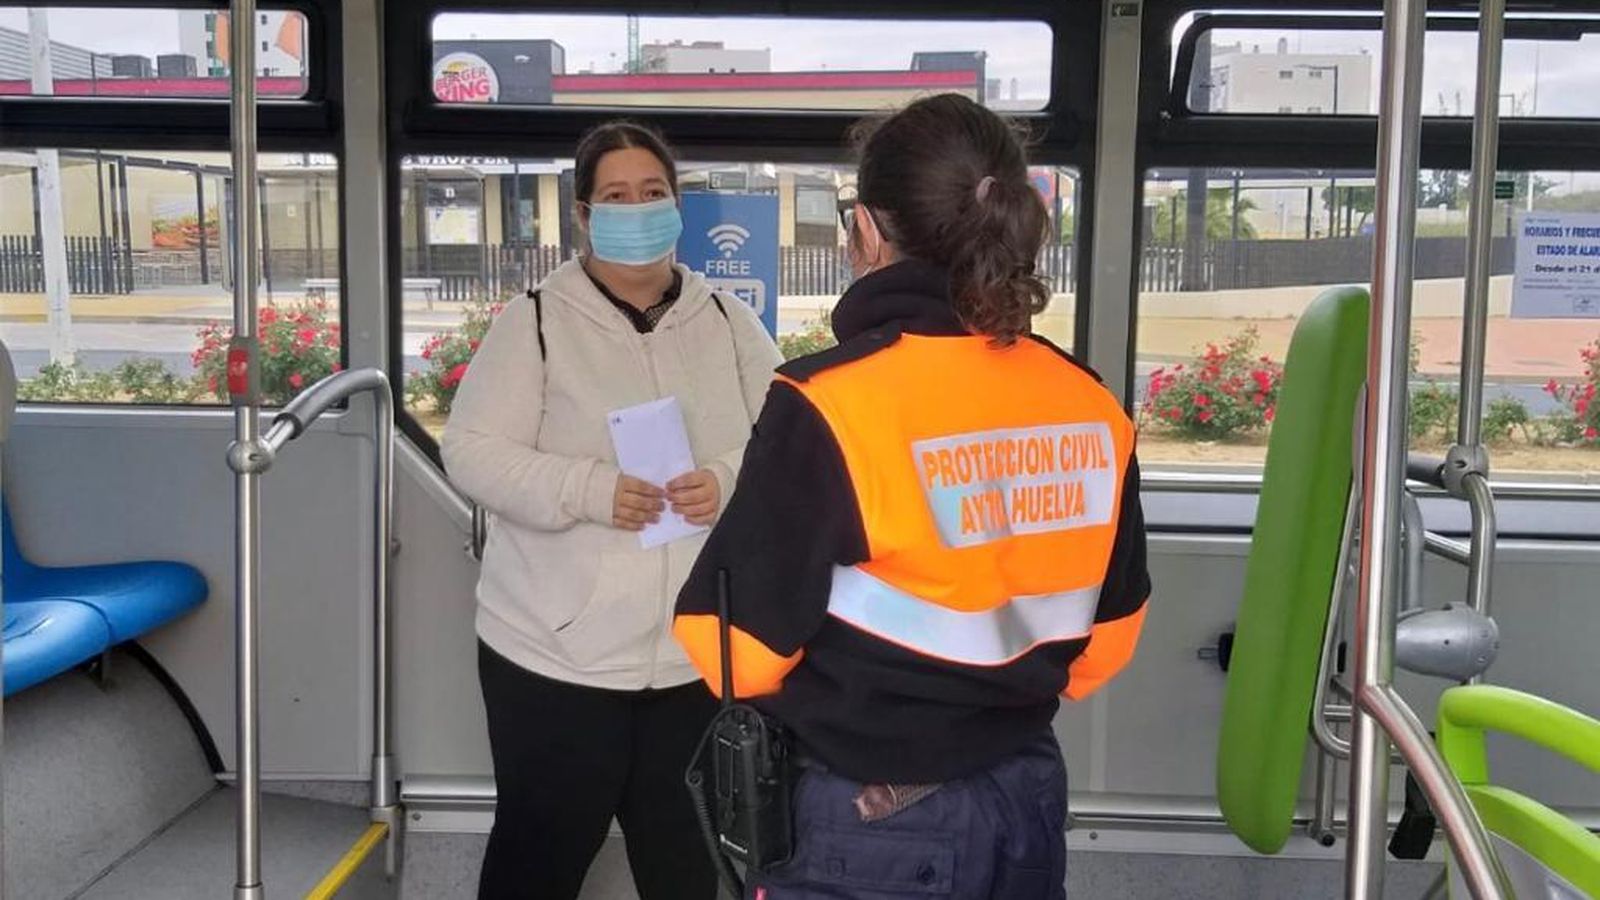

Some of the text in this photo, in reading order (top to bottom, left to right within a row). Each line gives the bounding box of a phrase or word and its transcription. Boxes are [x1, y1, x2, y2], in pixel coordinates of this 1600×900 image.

[1525, 226, 1563, 238] HORARIOS
[1565, 227, 1571, 238] Y
[1536, 244, 1566, 256] ESTADO
[1567, 245, 1578, 256] DE
[705, 260, 751, 275] FREE
[1534, 264, 1564, 273] Desde
[922, 432, 1109, 490] PROTECCION CIVIL
[1012, 481, 1086, 525] HUELVA
